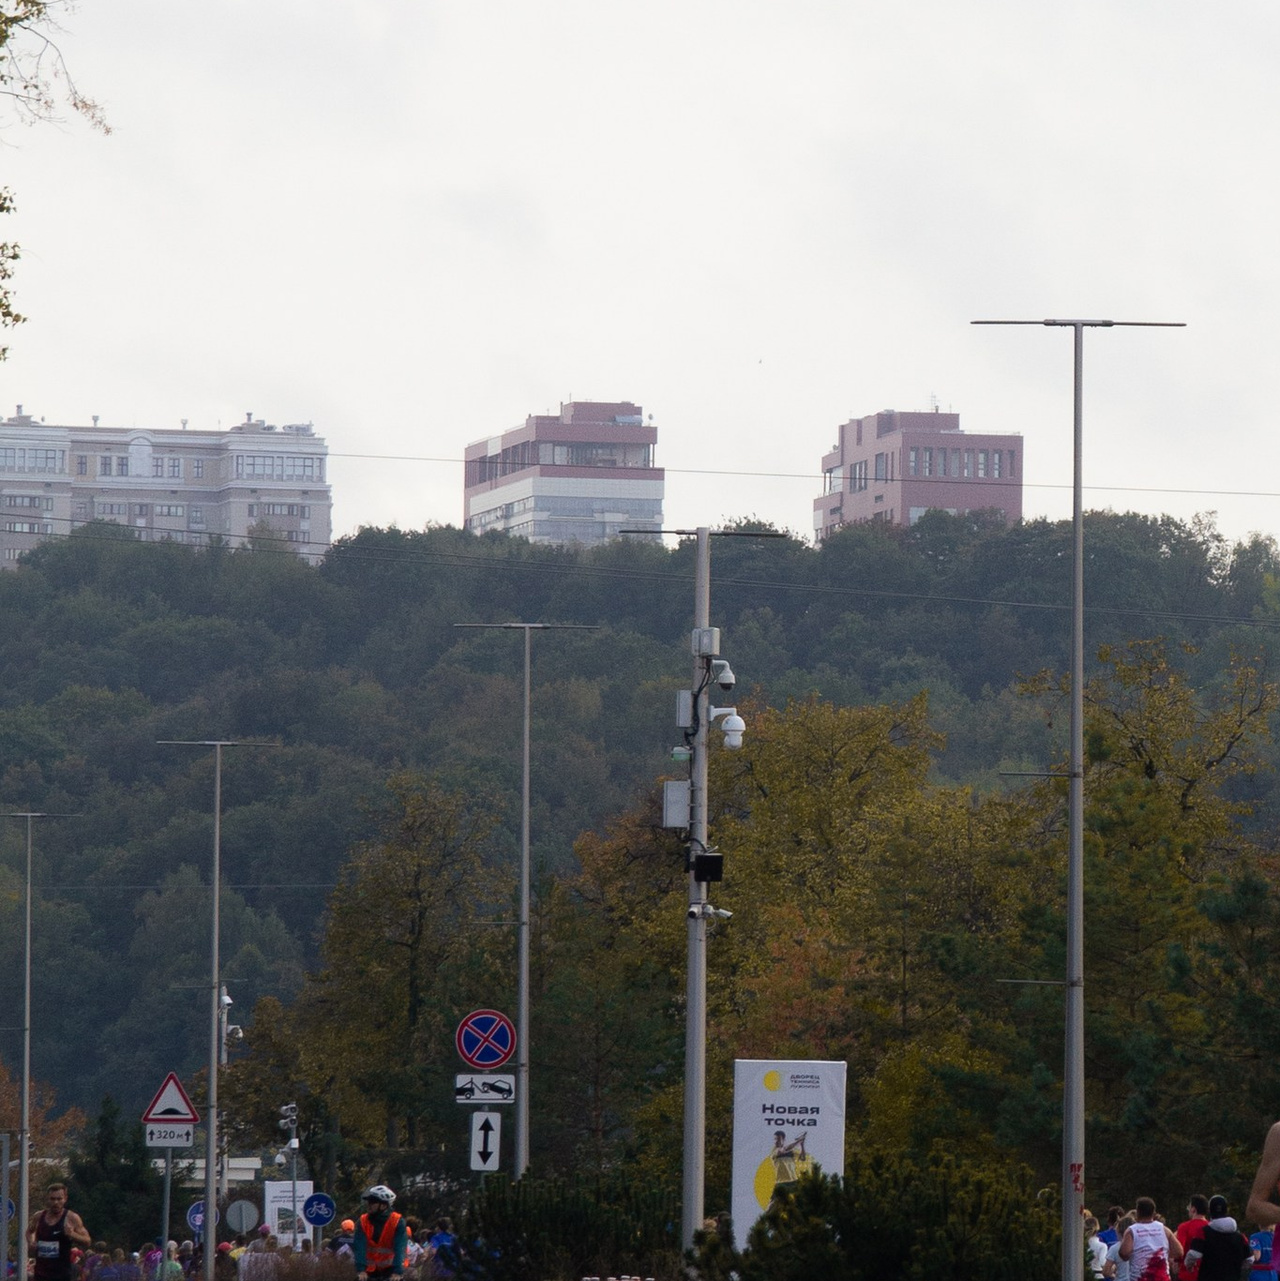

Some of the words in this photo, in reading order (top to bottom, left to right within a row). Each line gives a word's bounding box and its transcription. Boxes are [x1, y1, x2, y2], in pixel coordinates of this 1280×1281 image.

[762, 1104, 820, 1115] Новая
[765, 1118, 817, 1127] точка
[156, 1130, 176, 1140] 320
